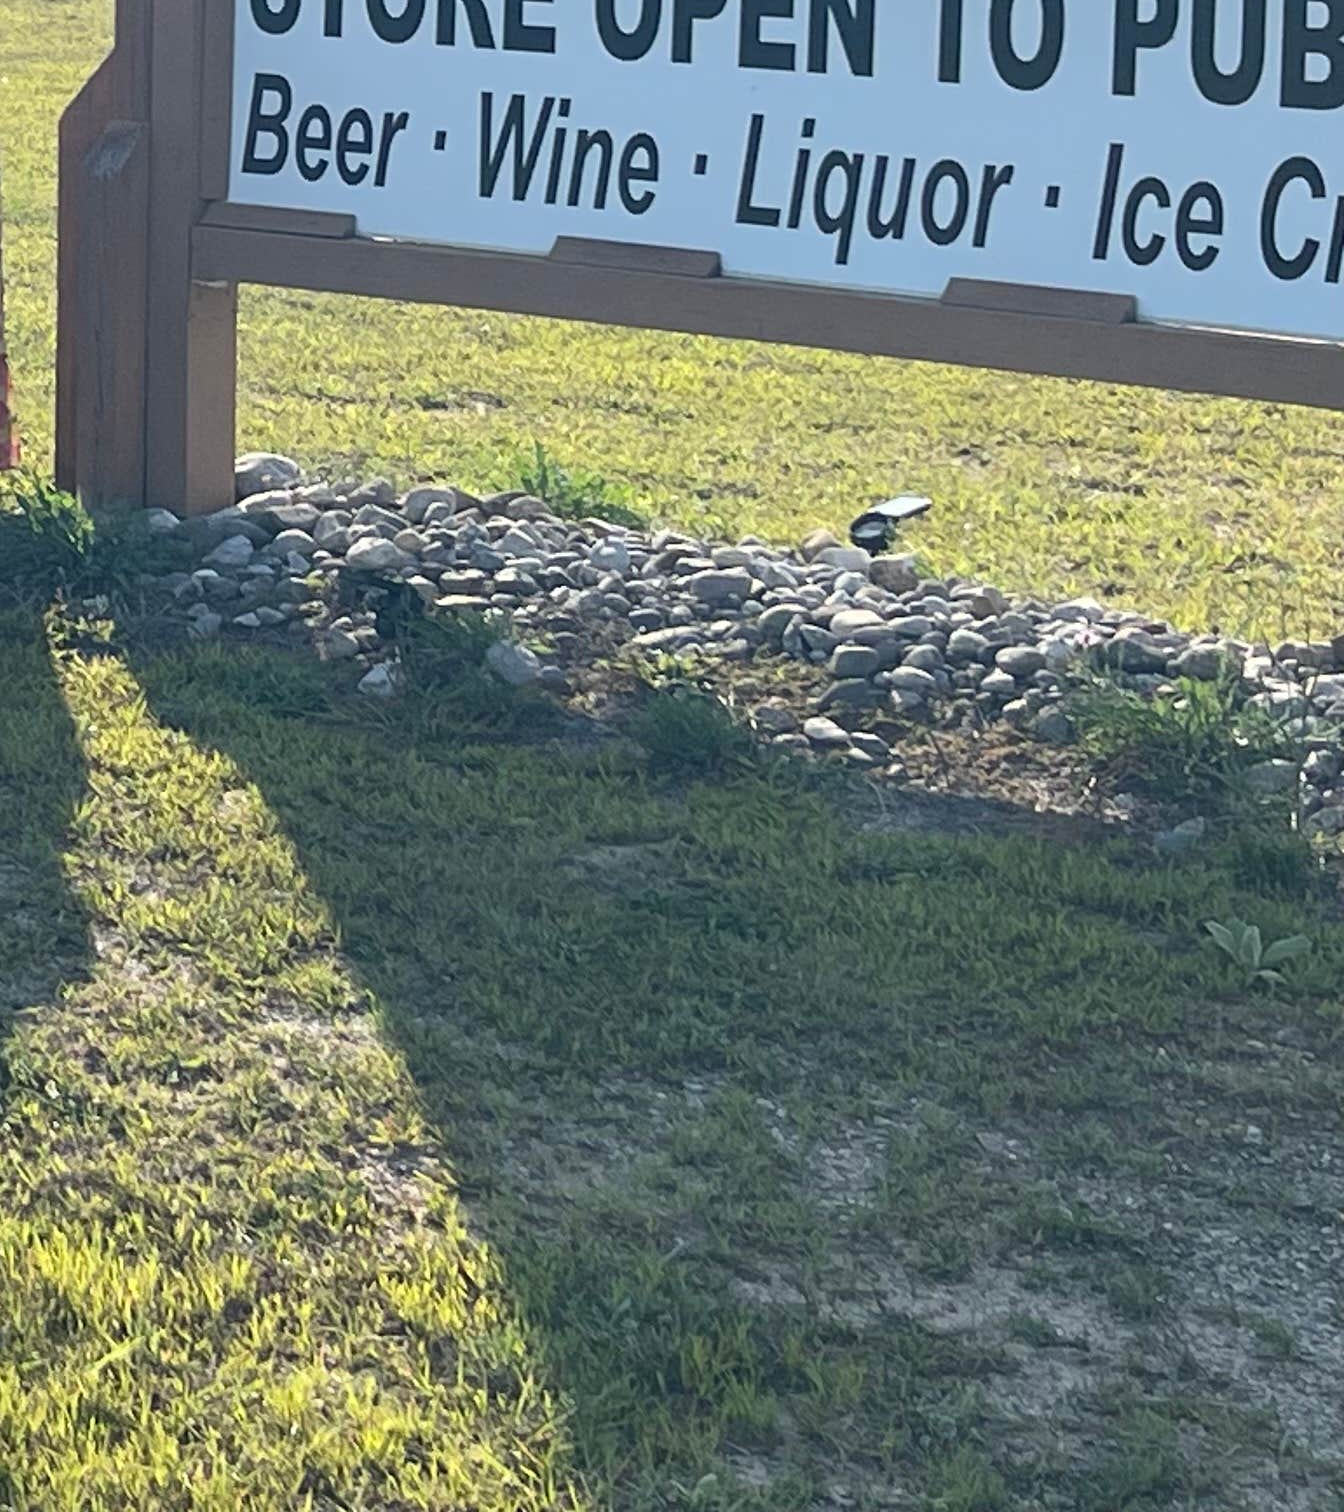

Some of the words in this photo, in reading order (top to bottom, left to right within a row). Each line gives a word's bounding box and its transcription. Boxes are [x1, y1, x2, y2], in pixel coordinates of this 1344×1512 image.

[241, 72, 410, 188] Beer
[479, 91, 660, 215] Wine
[735, 113, 1015, 266] Liquor
[1092, 142, 1224, 272] Ice
